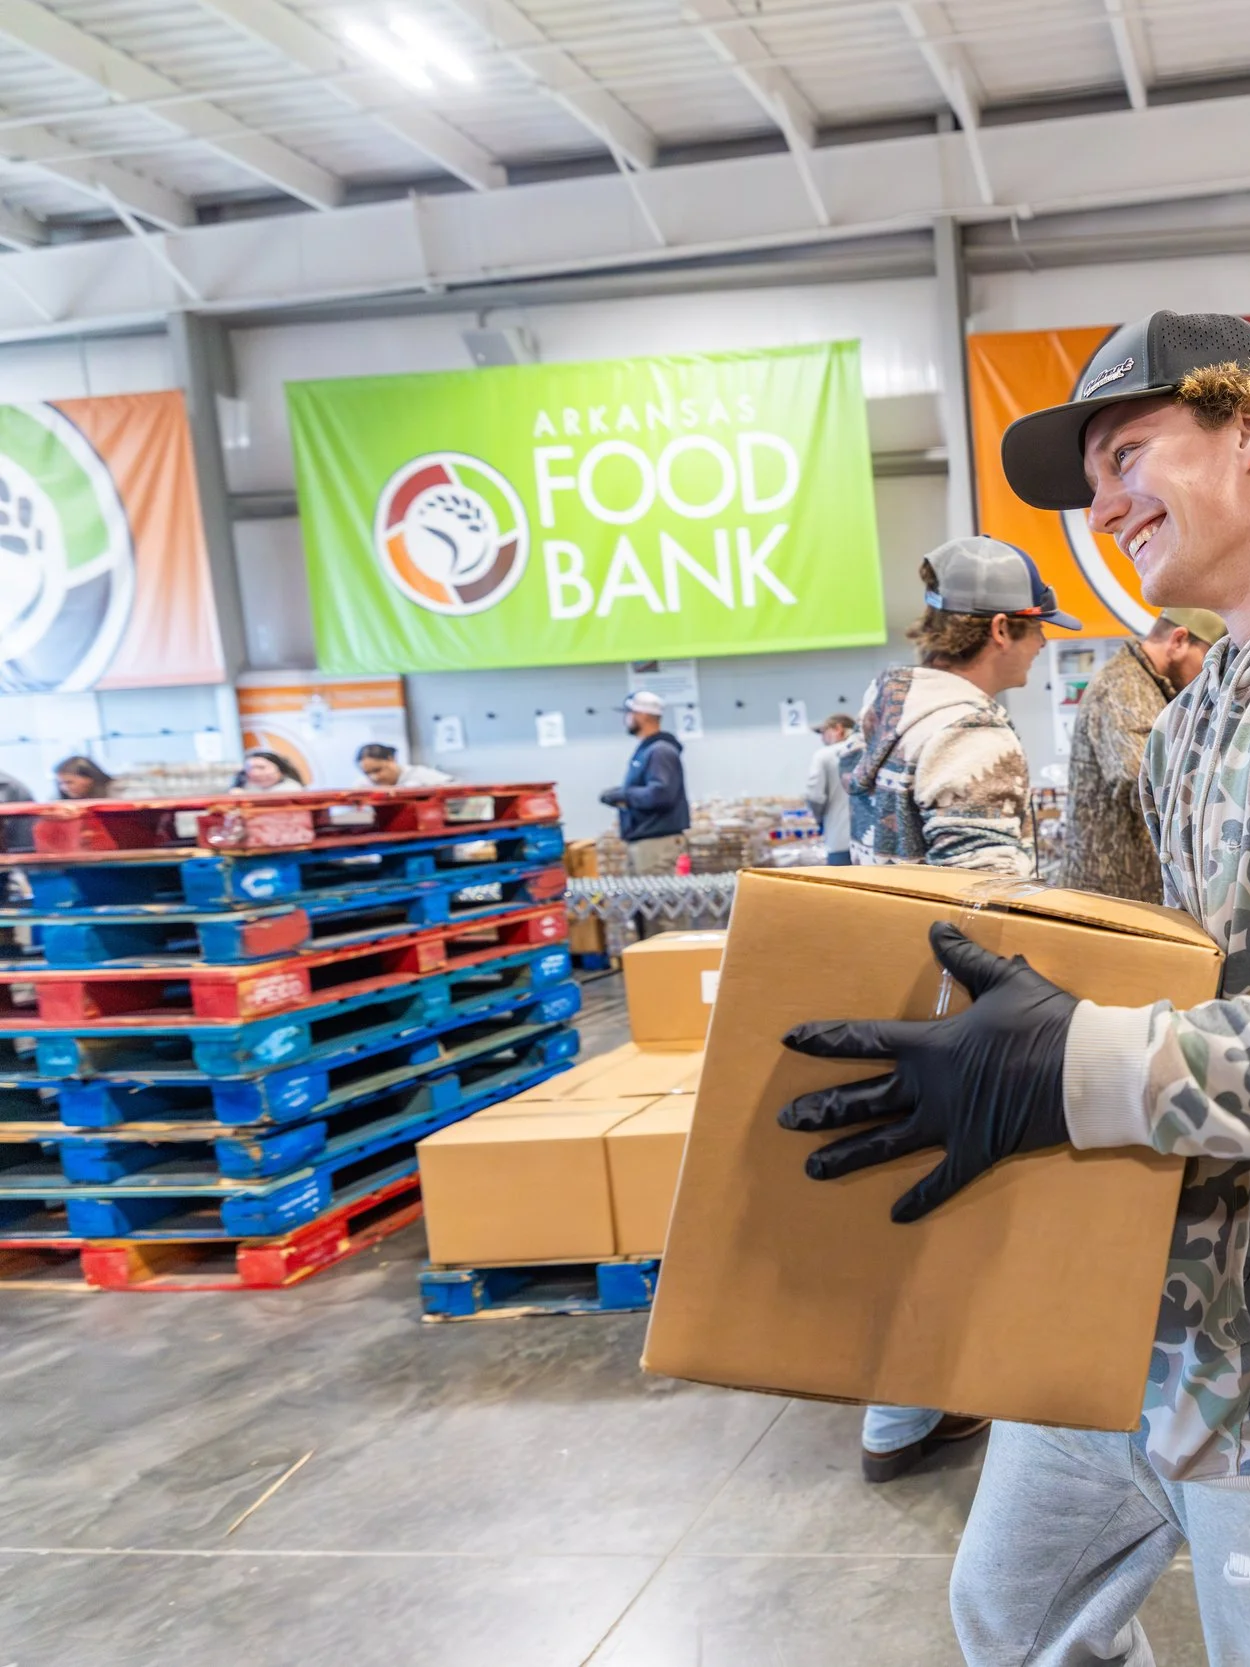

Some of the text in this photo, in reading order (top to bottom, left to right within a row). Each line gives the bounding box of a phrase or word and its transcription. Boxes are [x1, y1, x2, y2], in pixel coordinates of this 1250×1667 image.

[534, 395, 757, 436] ARKANSAS
[533, 432, 799, 528] FOOD
[543, 523, 798, 621] BANK
[683, 715, 696, 732] 2
[788, 709, 800, 726] 2
